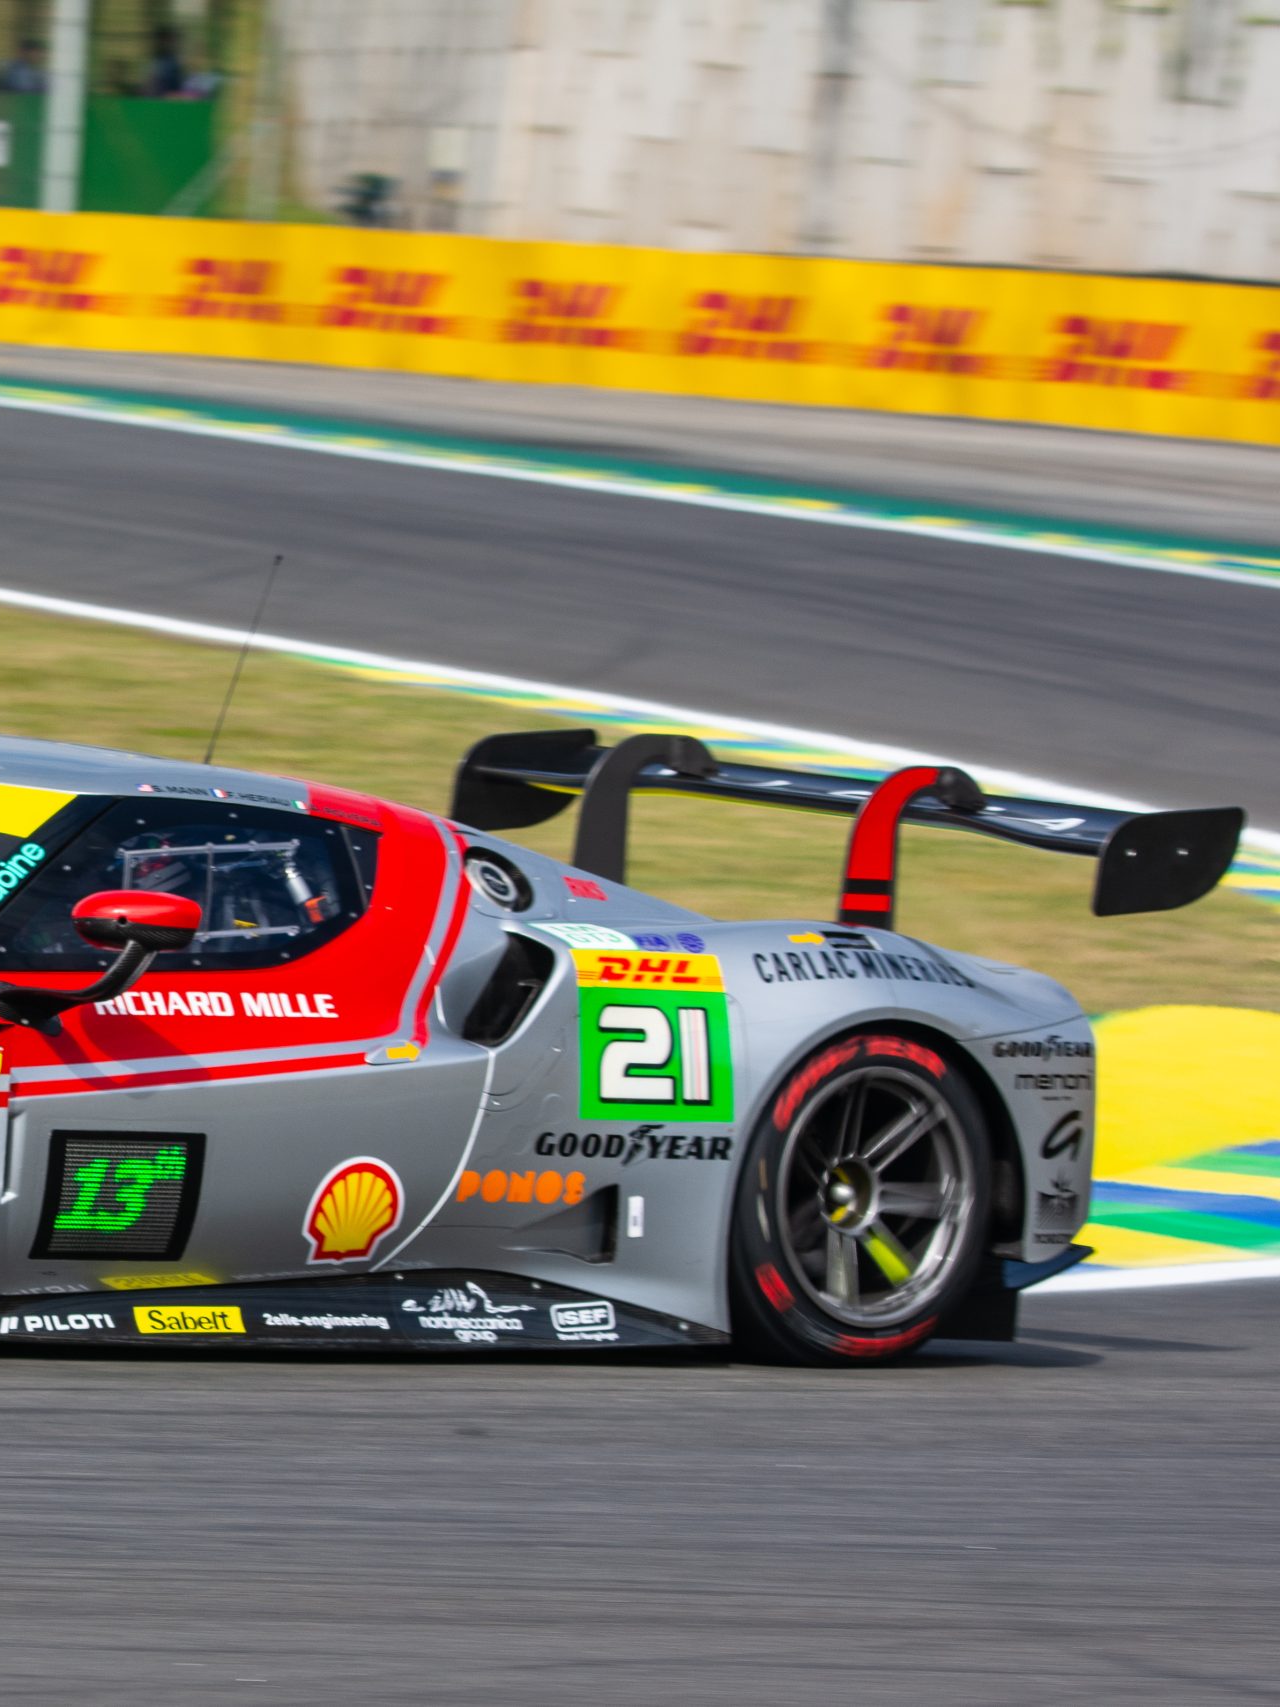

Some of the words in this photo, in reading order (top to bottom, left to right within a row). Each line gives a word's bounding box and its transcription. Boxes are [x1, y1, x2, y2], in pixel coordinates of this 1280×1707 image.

[597, 956, 702, 984] DHL
[752, 951, 857, 984] CARLAC
[94, 991, 235, 1017] RICHARD
[240, 992, 340, 1018] MILLE
[598, 1003, 714, 1106] 21
[535, 1130, 733, 1162] GOODYEAR
[456, 1169, 586, 1205] PONOS
[24, 1313, 116, 1332] PILOTI
[148, 1310, 232, 1331] Sabelt
[262, 1313, 391, 1330] 2elle-engineering
[558, 1308, 608, 1326] ISEF
